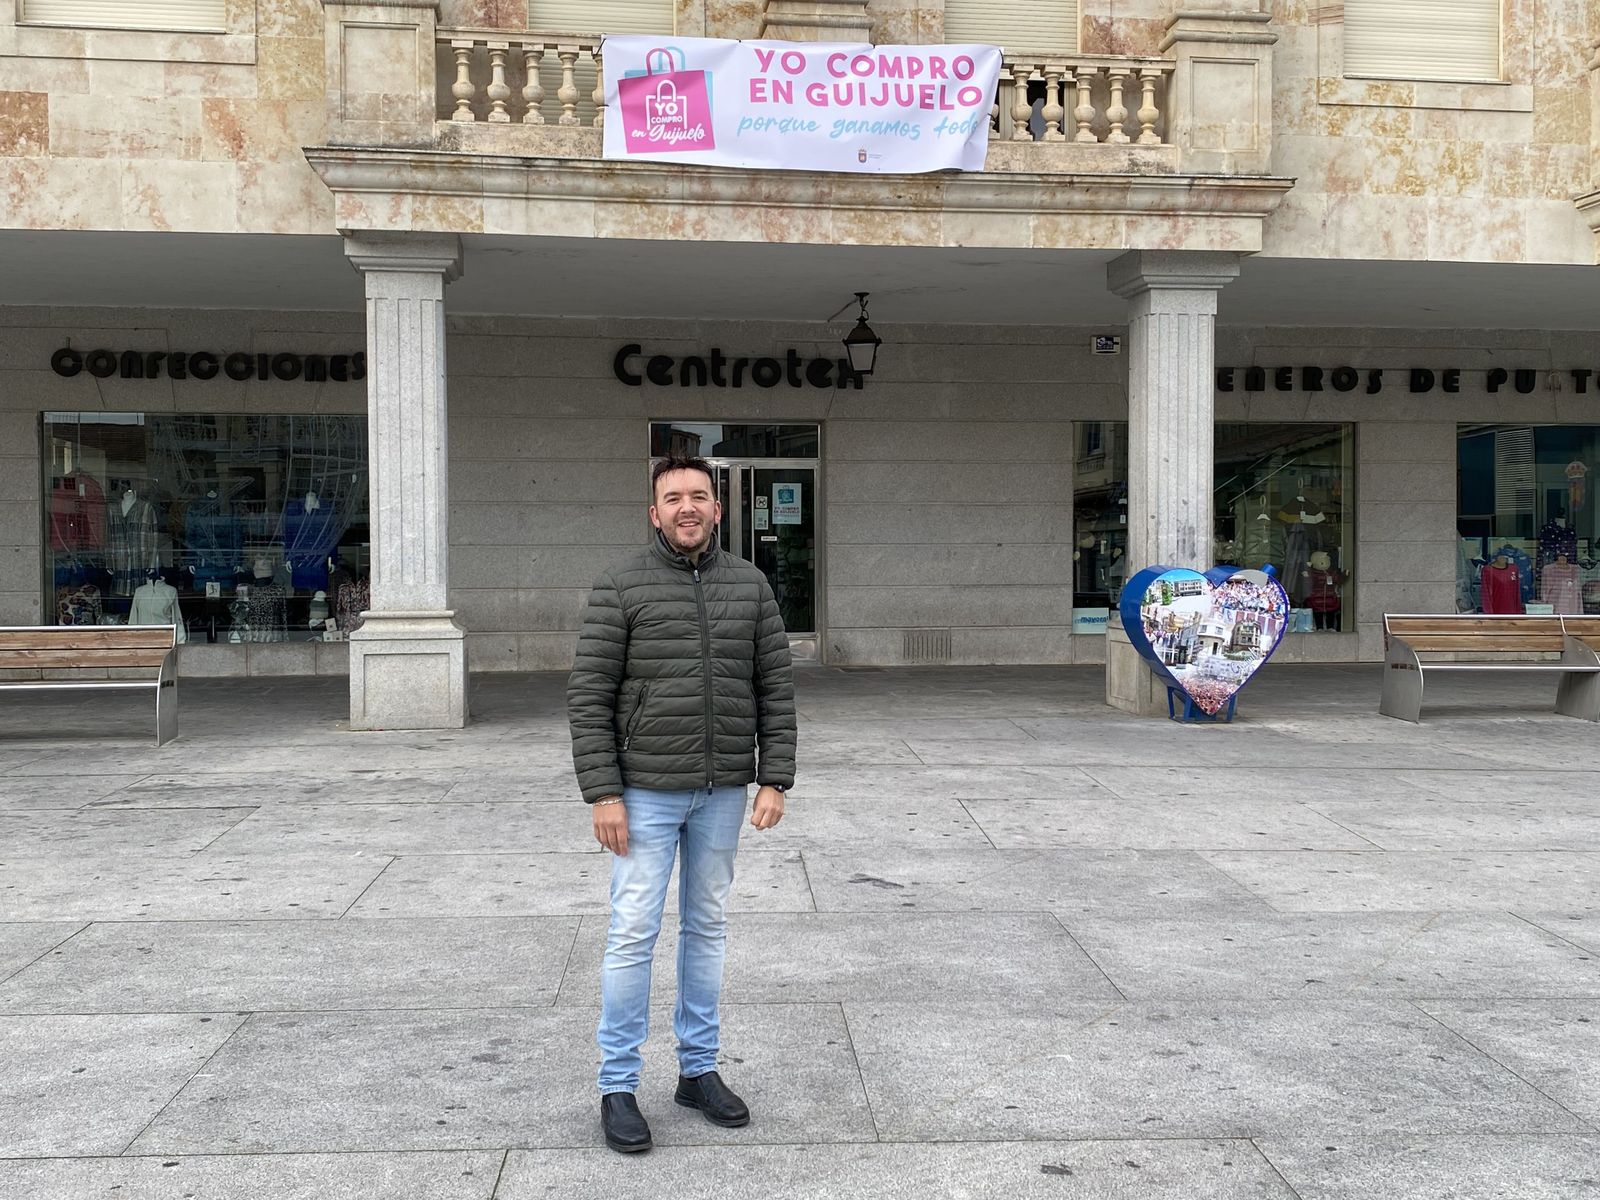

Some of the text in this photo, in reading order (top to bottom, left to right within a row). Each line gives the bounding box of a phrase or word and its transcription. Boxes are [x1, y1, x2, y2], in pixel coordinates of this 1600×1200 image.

[754, 49, 975, 80] YO COMPRO
[750, 78, 983, 110] EN GUIJUELO
[651, 116, 683, 124] COMPRO
[655, 103, 678, 115] YO
[631, 123, 705, 145] en Guijuelo
[737, 116, 821, 137] porque
[829, 118, 921, 140] ganamos
[51, 348, 366, 382] CONFECCIONES
[614, 344, 864, 389] Centrotex
[1217, 366, 1600, 394] ENEROS DE PUT
